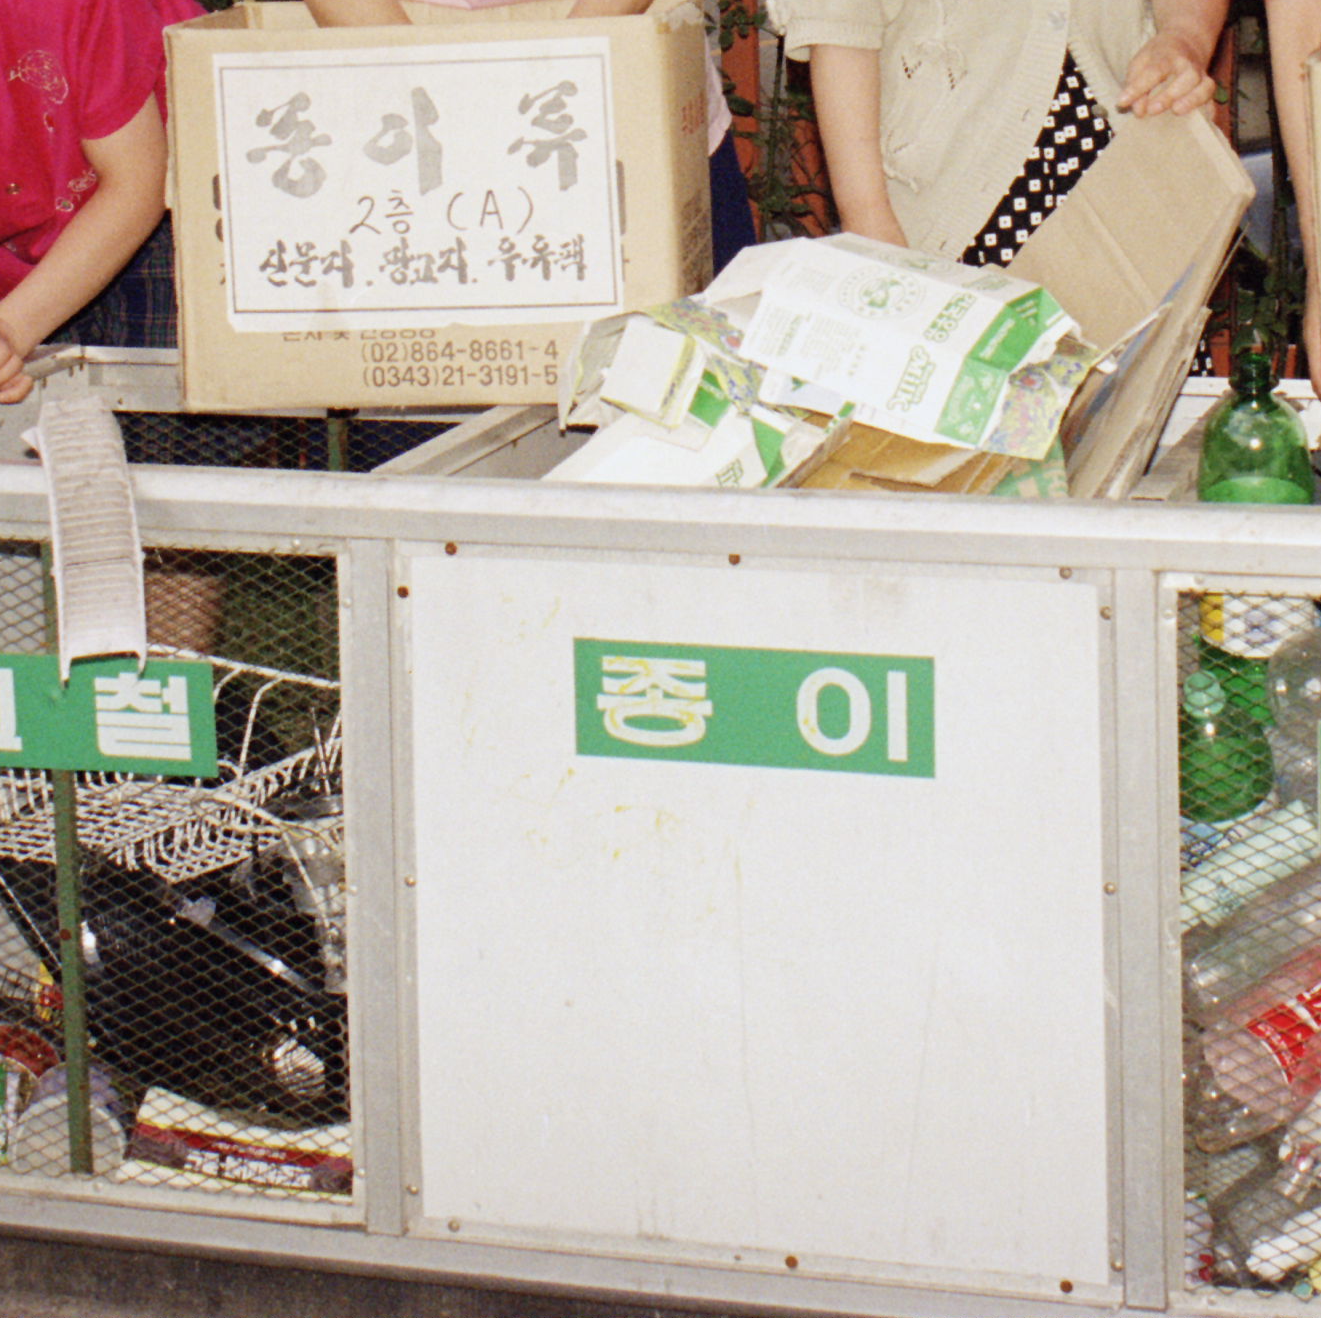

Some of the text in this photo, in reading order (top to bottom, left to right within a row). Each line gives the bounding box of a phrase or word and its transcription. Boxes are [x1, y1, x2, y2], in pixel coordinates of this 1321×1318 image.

[349, 186, 534, 235] 2층 (A)
[595, 655, 909, 762] 종이
